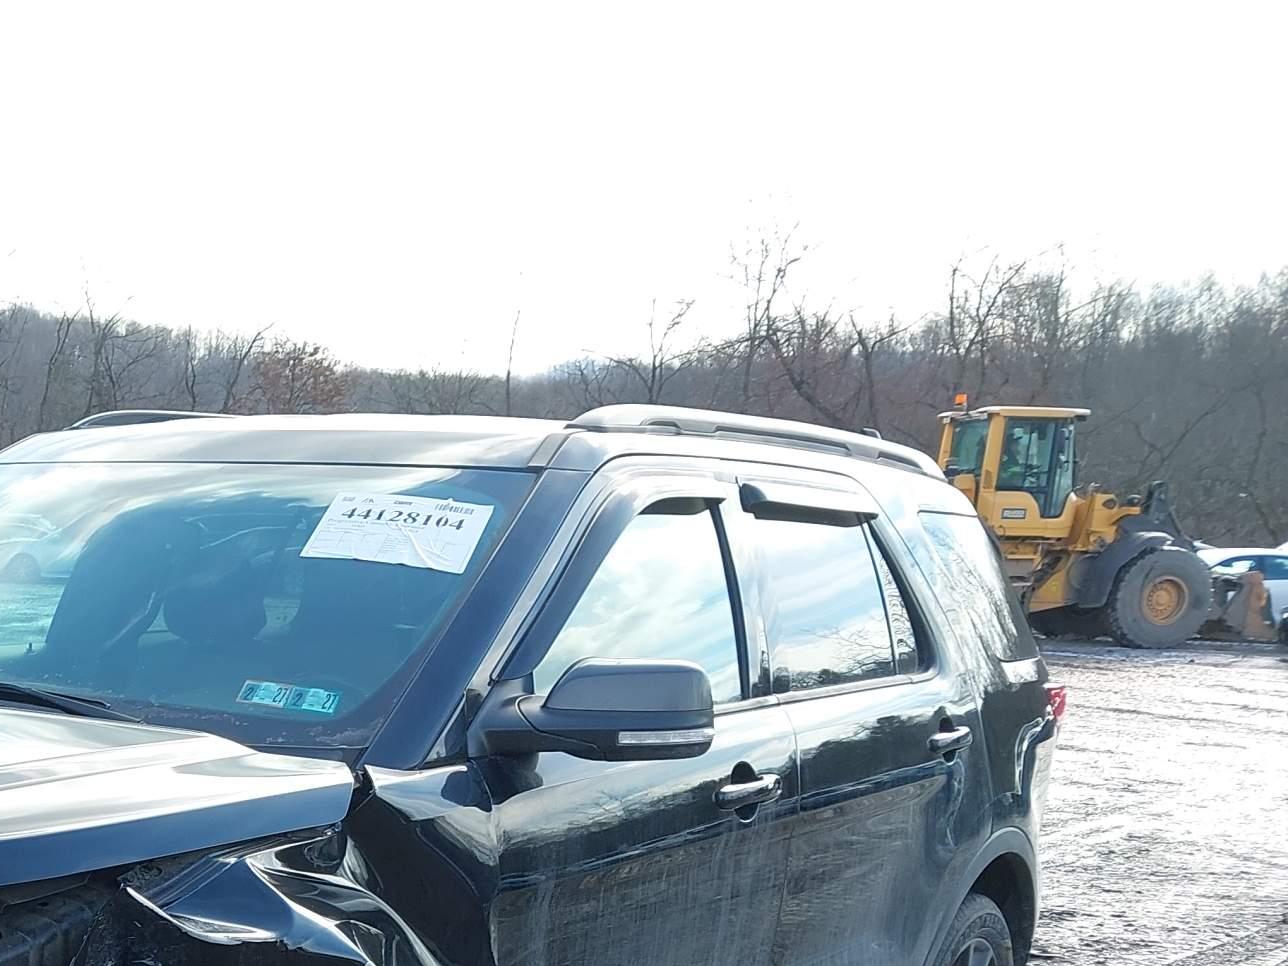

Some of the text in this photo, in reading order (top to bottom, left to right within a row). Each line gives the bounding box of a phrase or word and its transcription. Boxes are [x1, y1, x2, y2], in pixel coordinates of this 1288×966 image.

[340, 507, 465, 531] 44128104
[272, 687, 289, 705] 27
[322, 693, 337, 711] 27
